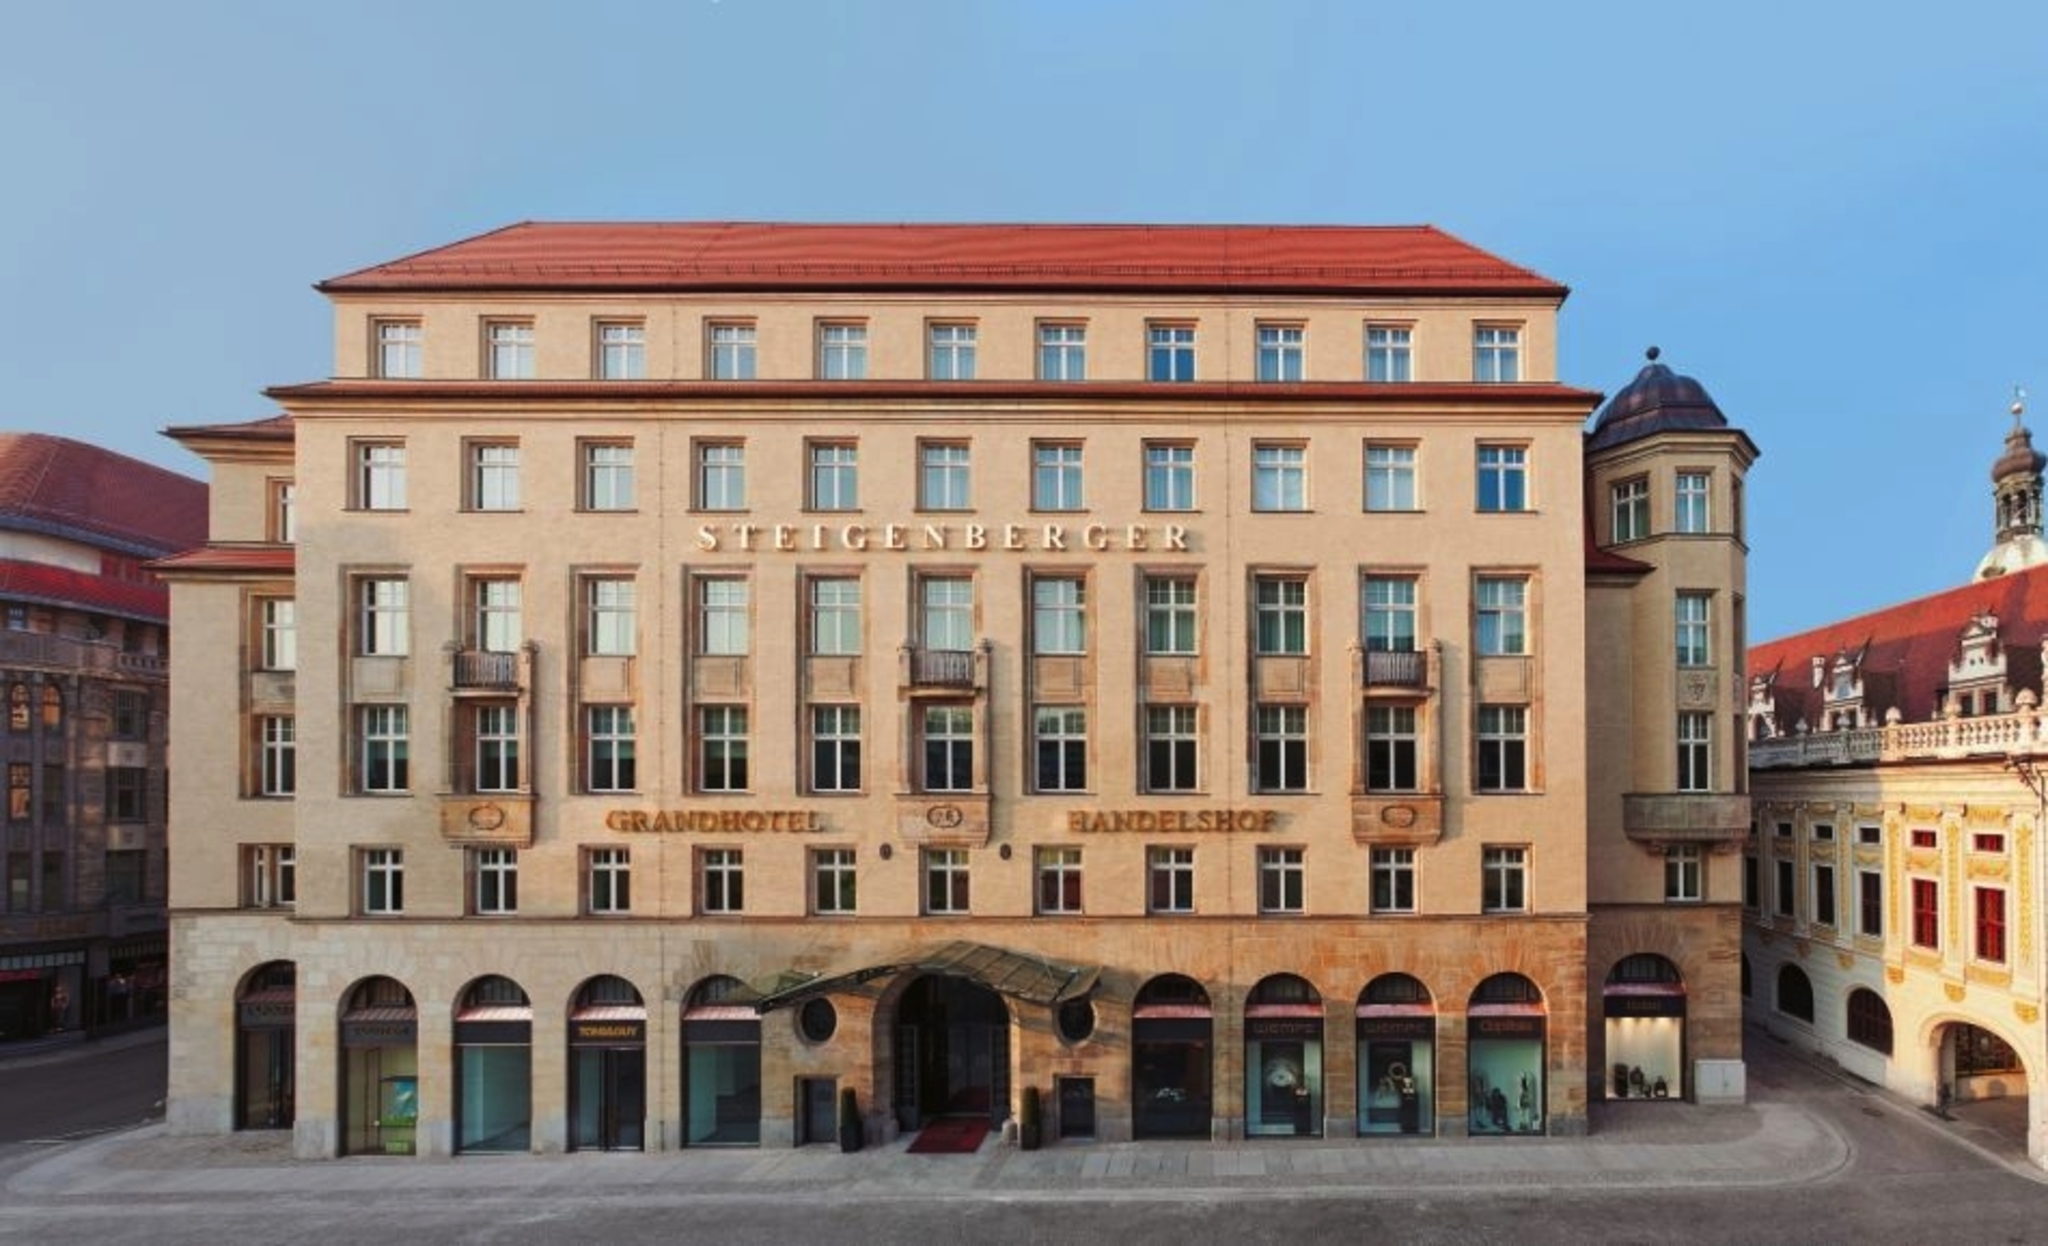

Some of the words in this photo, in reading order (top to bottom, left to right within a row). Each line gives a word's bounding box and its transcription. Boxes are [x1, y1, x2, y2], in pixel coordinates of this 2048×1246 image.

[697, 523, 1188, 550] STEIGENBERGER
[606, 810, 825, 832] GRANDHOTEL
[1067, 810, 1278, 832] HANDELSHOF
